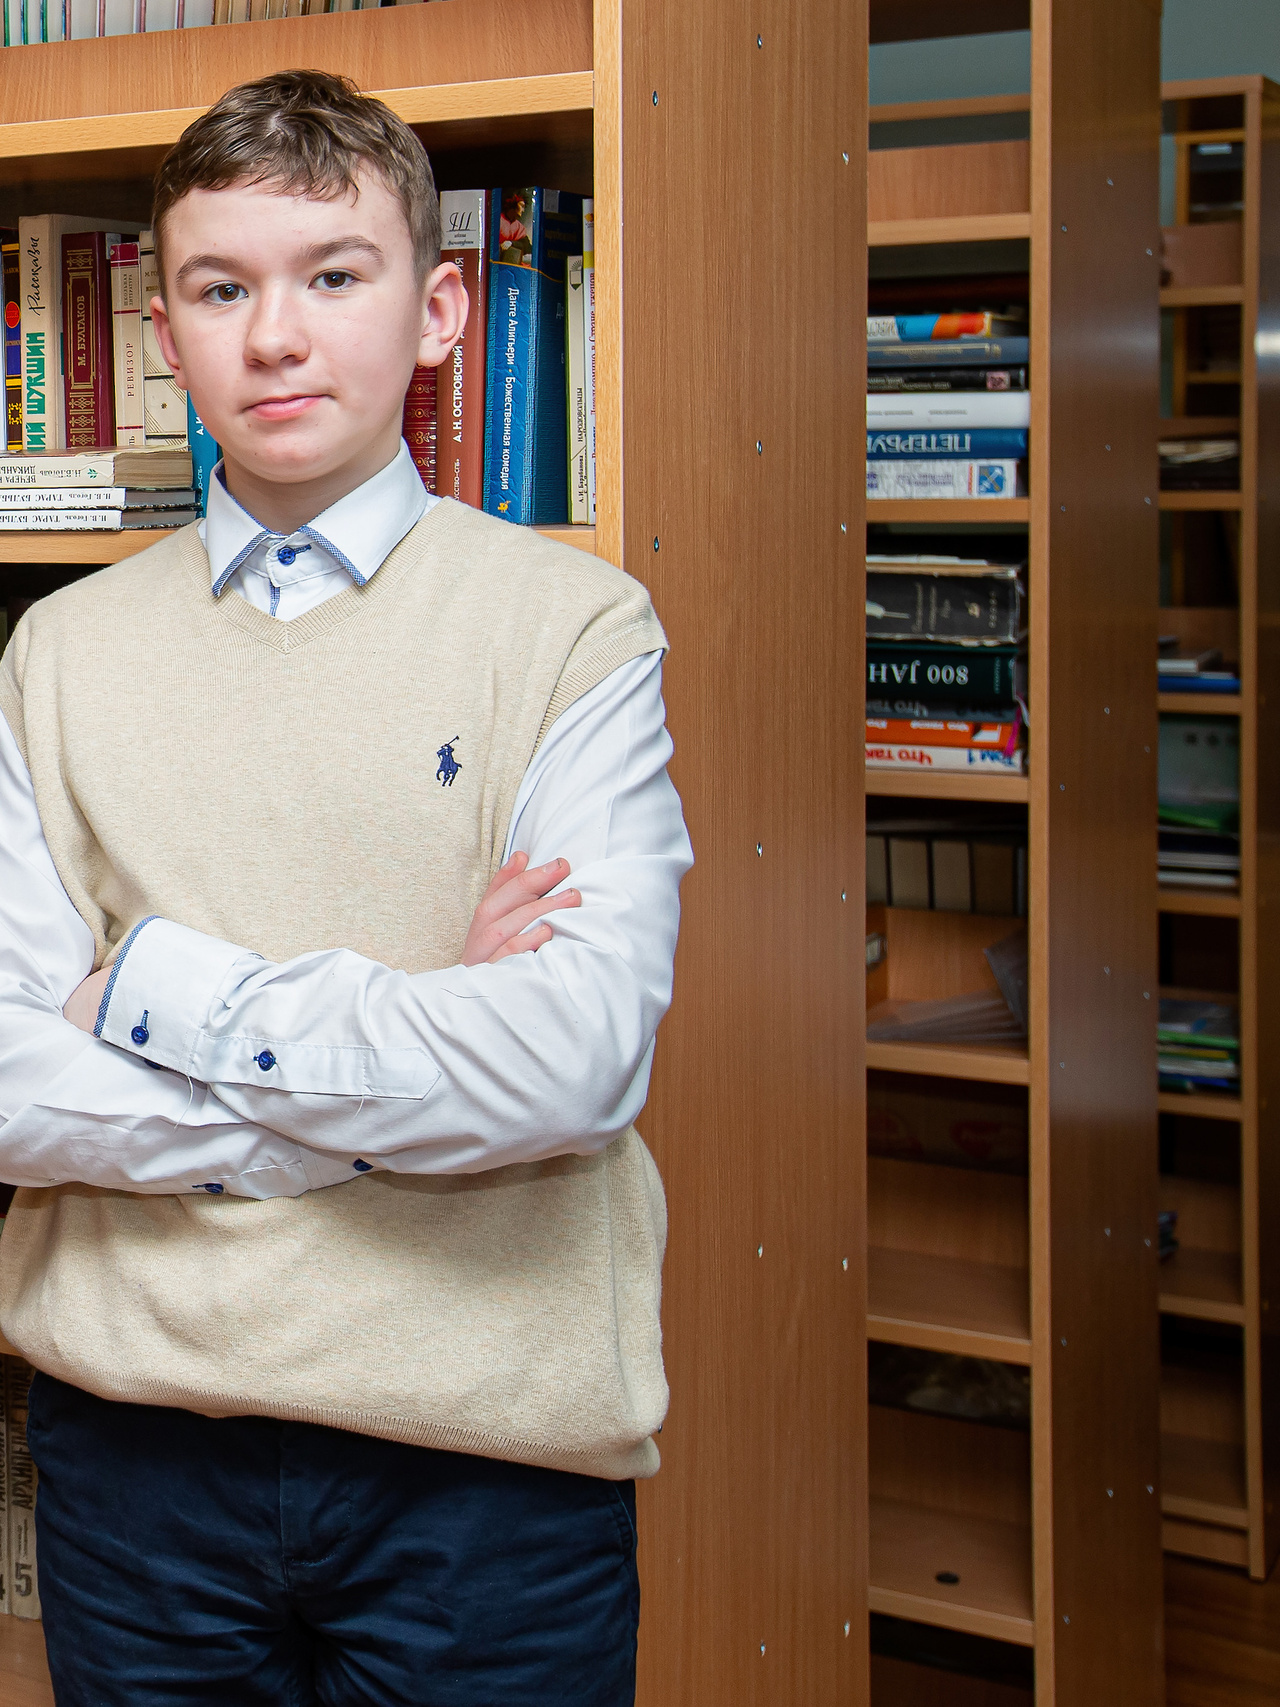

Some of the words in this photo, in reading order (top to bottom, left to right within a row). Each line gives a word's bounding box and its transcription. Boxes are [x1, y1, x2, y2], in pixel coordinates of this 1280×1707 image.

[26, 236, 46, 316] Рассказы
[508, 287, 519, 317] Данте
[77, 295, 86, 350] БУЛГАКОВ
[506, 319, 518, 365] Алигьери
[26, 332, 46, 415] ШУКШИН
[77, 354, 86, 366] М.
[126, 343, 135, 397] РЕВИЗОР
[452, 345, 463, 418] ОСТРОВСКИЙ
[453, 419, 463, 430] Н.
[503, 376, 516, 446] Божественная
[453, 431, 462, 442] А.
[5, 475, 36, 484] ВЕЧЕРА
[501, 449, 512, 490] комедия
[35, 493, 63, 501] ТАРАС
[32, 515, 60, 523] ТАРАС
[868, 660, 921, 684] JAH
[927, 664, 969, 685] 800
[898, 750, 932, 766] Что
[14, 1562, 32, 1598] 5
